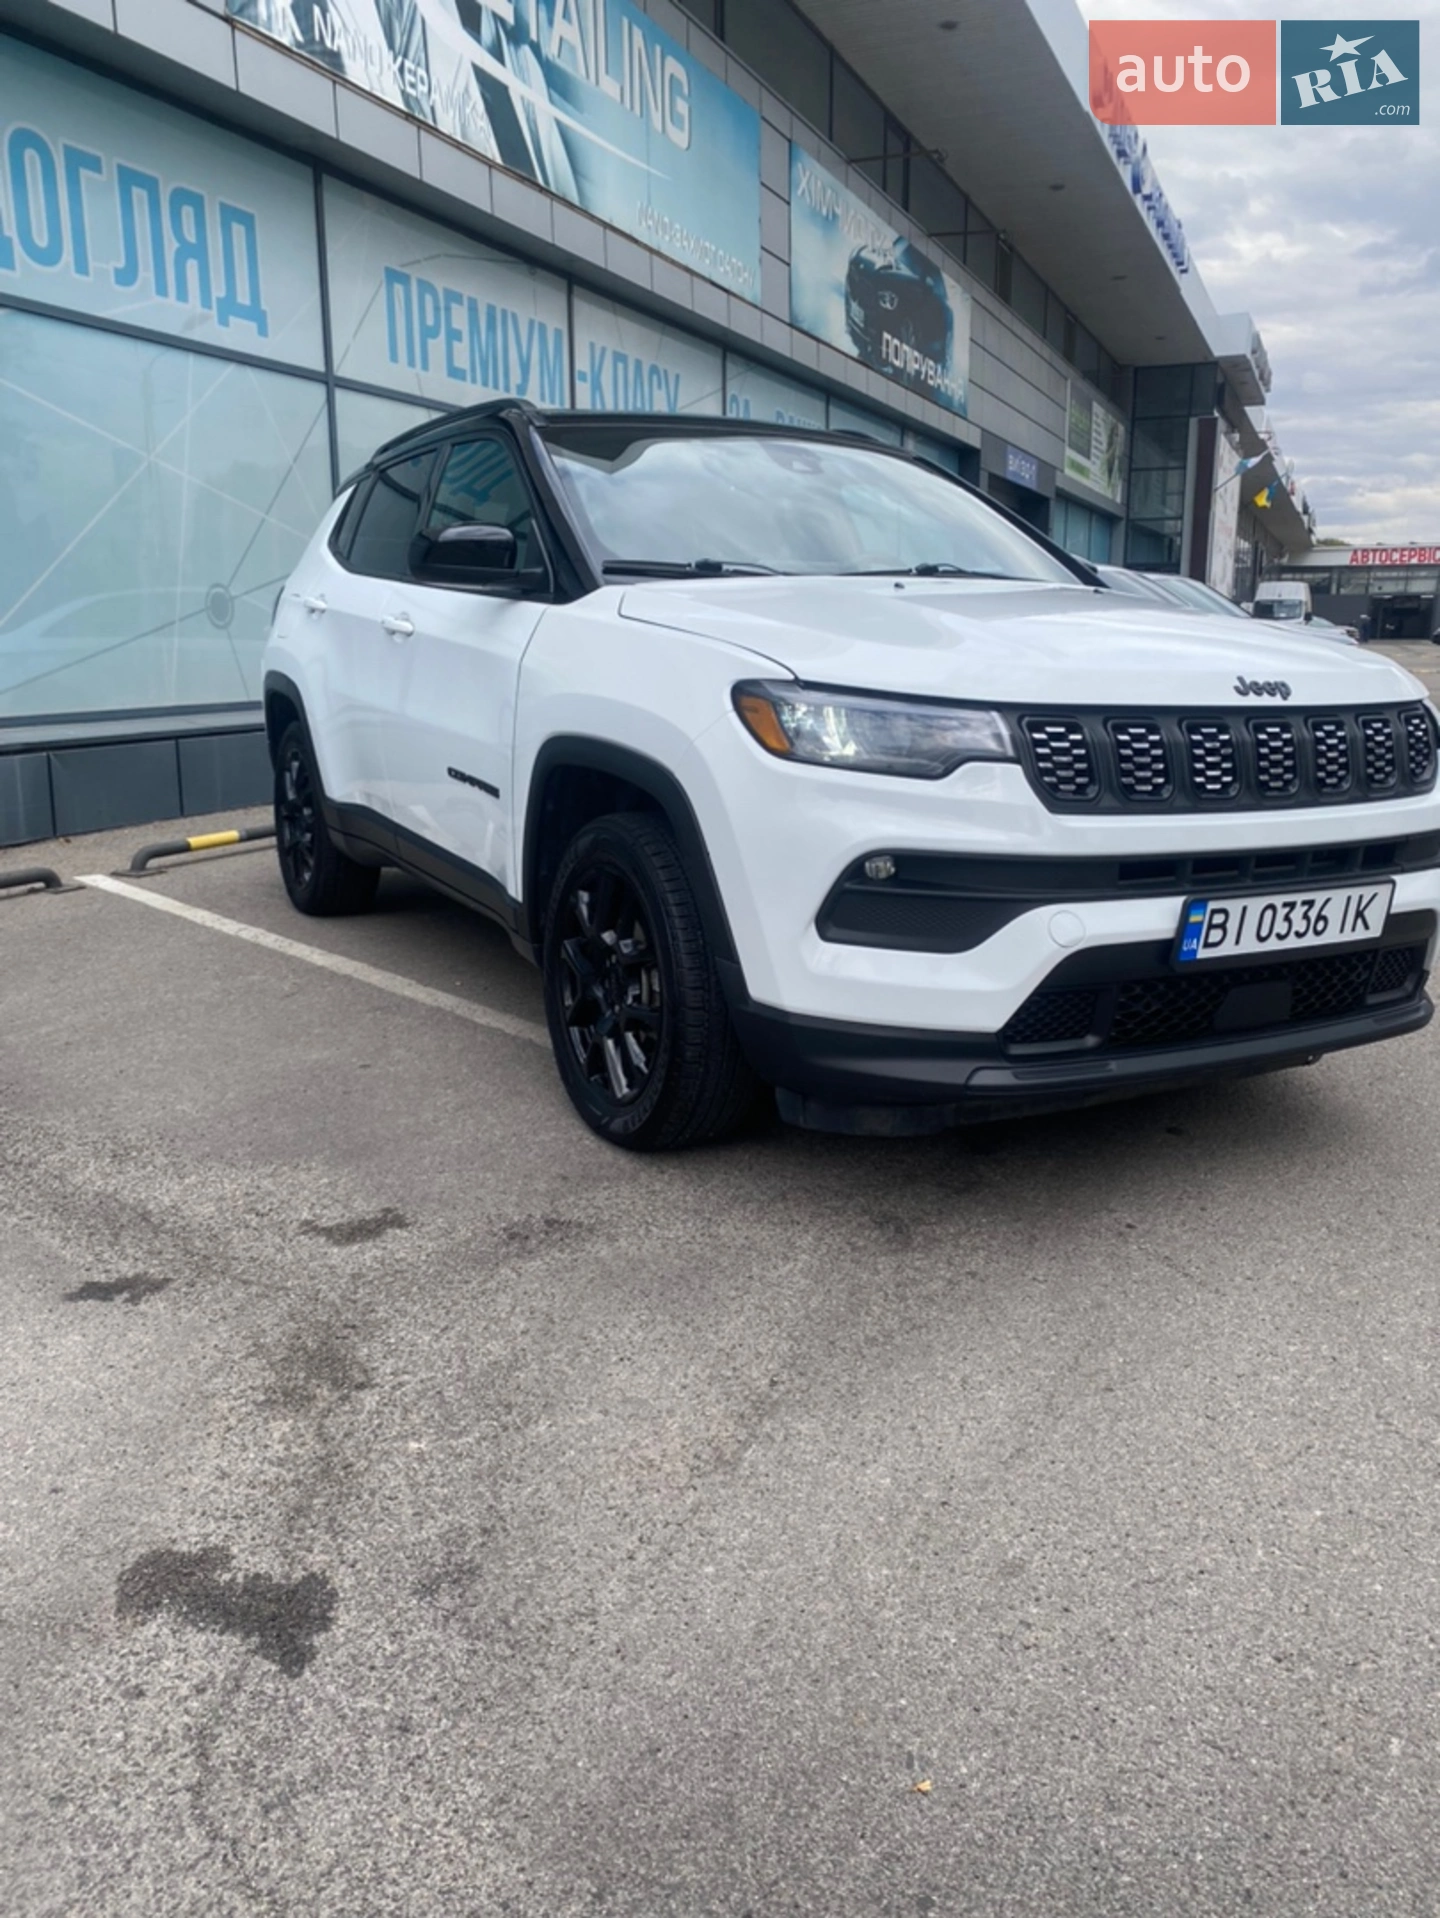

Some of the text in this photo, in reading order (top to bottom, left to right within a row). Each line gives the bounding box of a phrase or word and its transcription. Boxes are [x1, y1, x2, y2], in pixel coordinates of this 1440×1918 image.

[881, 331, 965, 404] ПОЛІРУВАННЯ
[1348, 546, 1440, 566] АВТОСЕРВІС
[1233, 675, 1292, 701] Jeep
[1202, 892, 1379, 949] BI 0336 IK
